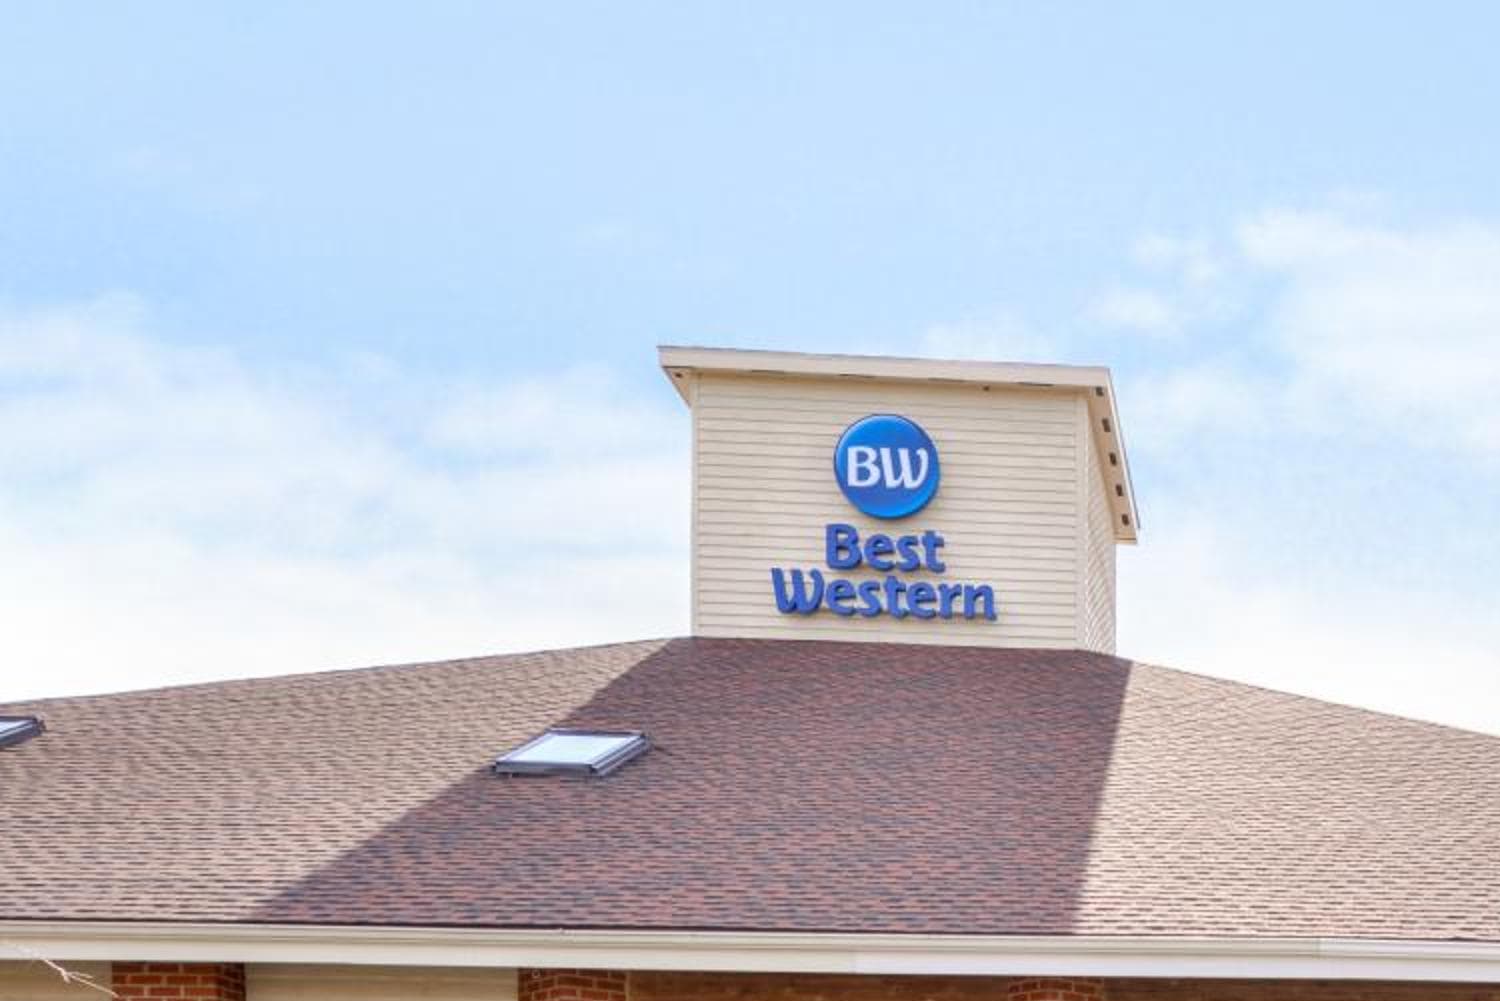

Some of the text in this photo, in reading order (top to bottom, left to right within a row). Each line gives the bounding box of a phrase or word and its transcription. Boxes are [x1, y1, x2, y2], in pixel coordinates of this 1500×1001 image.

[847, 446, 929, 489] BW
[825, 523, 945, 573] Best
[771, 567, 997, 621] Western
